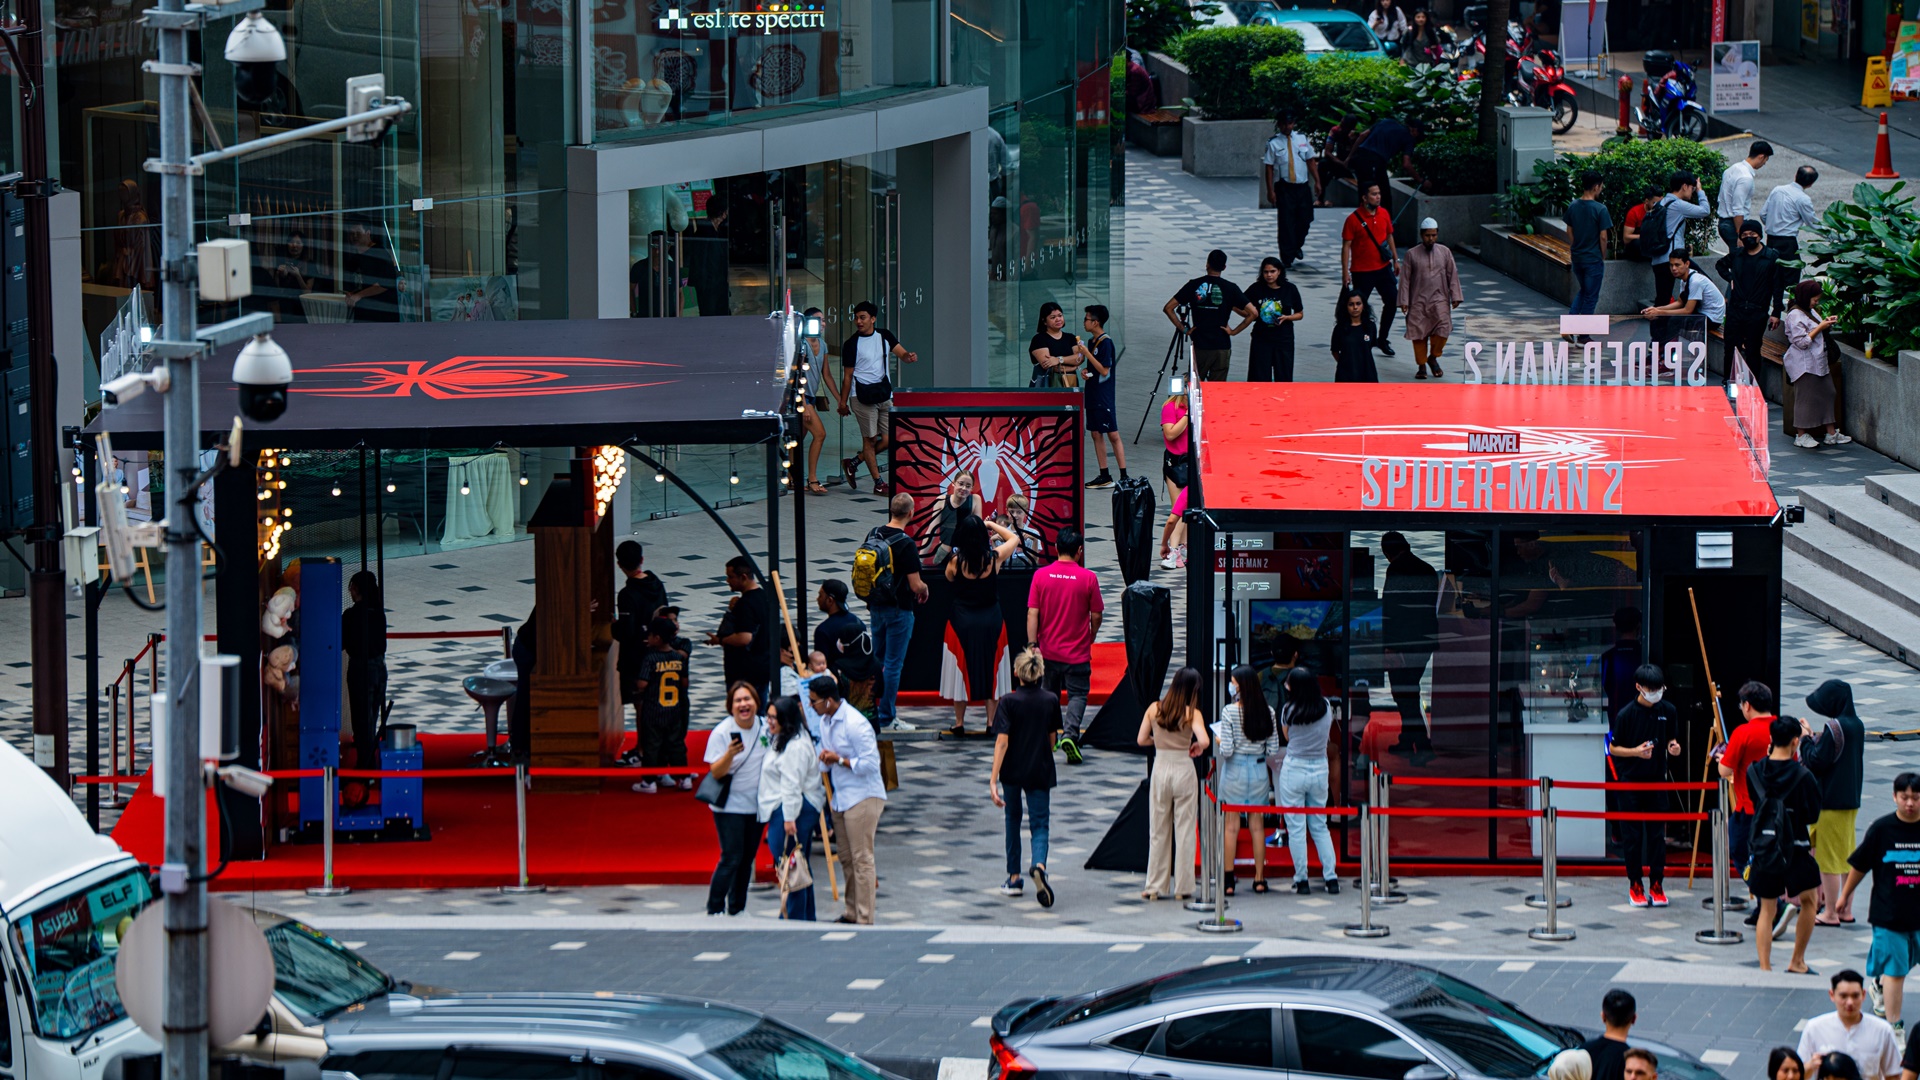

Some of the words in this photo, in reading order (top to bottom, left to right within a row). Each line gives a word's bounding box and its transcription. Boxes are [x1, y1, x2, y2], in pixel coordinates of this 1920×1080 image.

[694, 8, 751, 29] eslte
[1468, 433, 1520, 453] MARVEL
[1362, 458, 1589, 512] SPIDER-MAN
[1603, 462, 1624, 511] 2
[1232, 538, 1264, 548] PS5
[1264, 558, 1269, 568] 2
[1237, 581, 1270, 591] PS5
[656, 660, 683, 672] JAMES
[659, 672, 679, 707] 6
[100, 883, 133, 909] ELF
[38, 907, 79, 937] ISUZU
